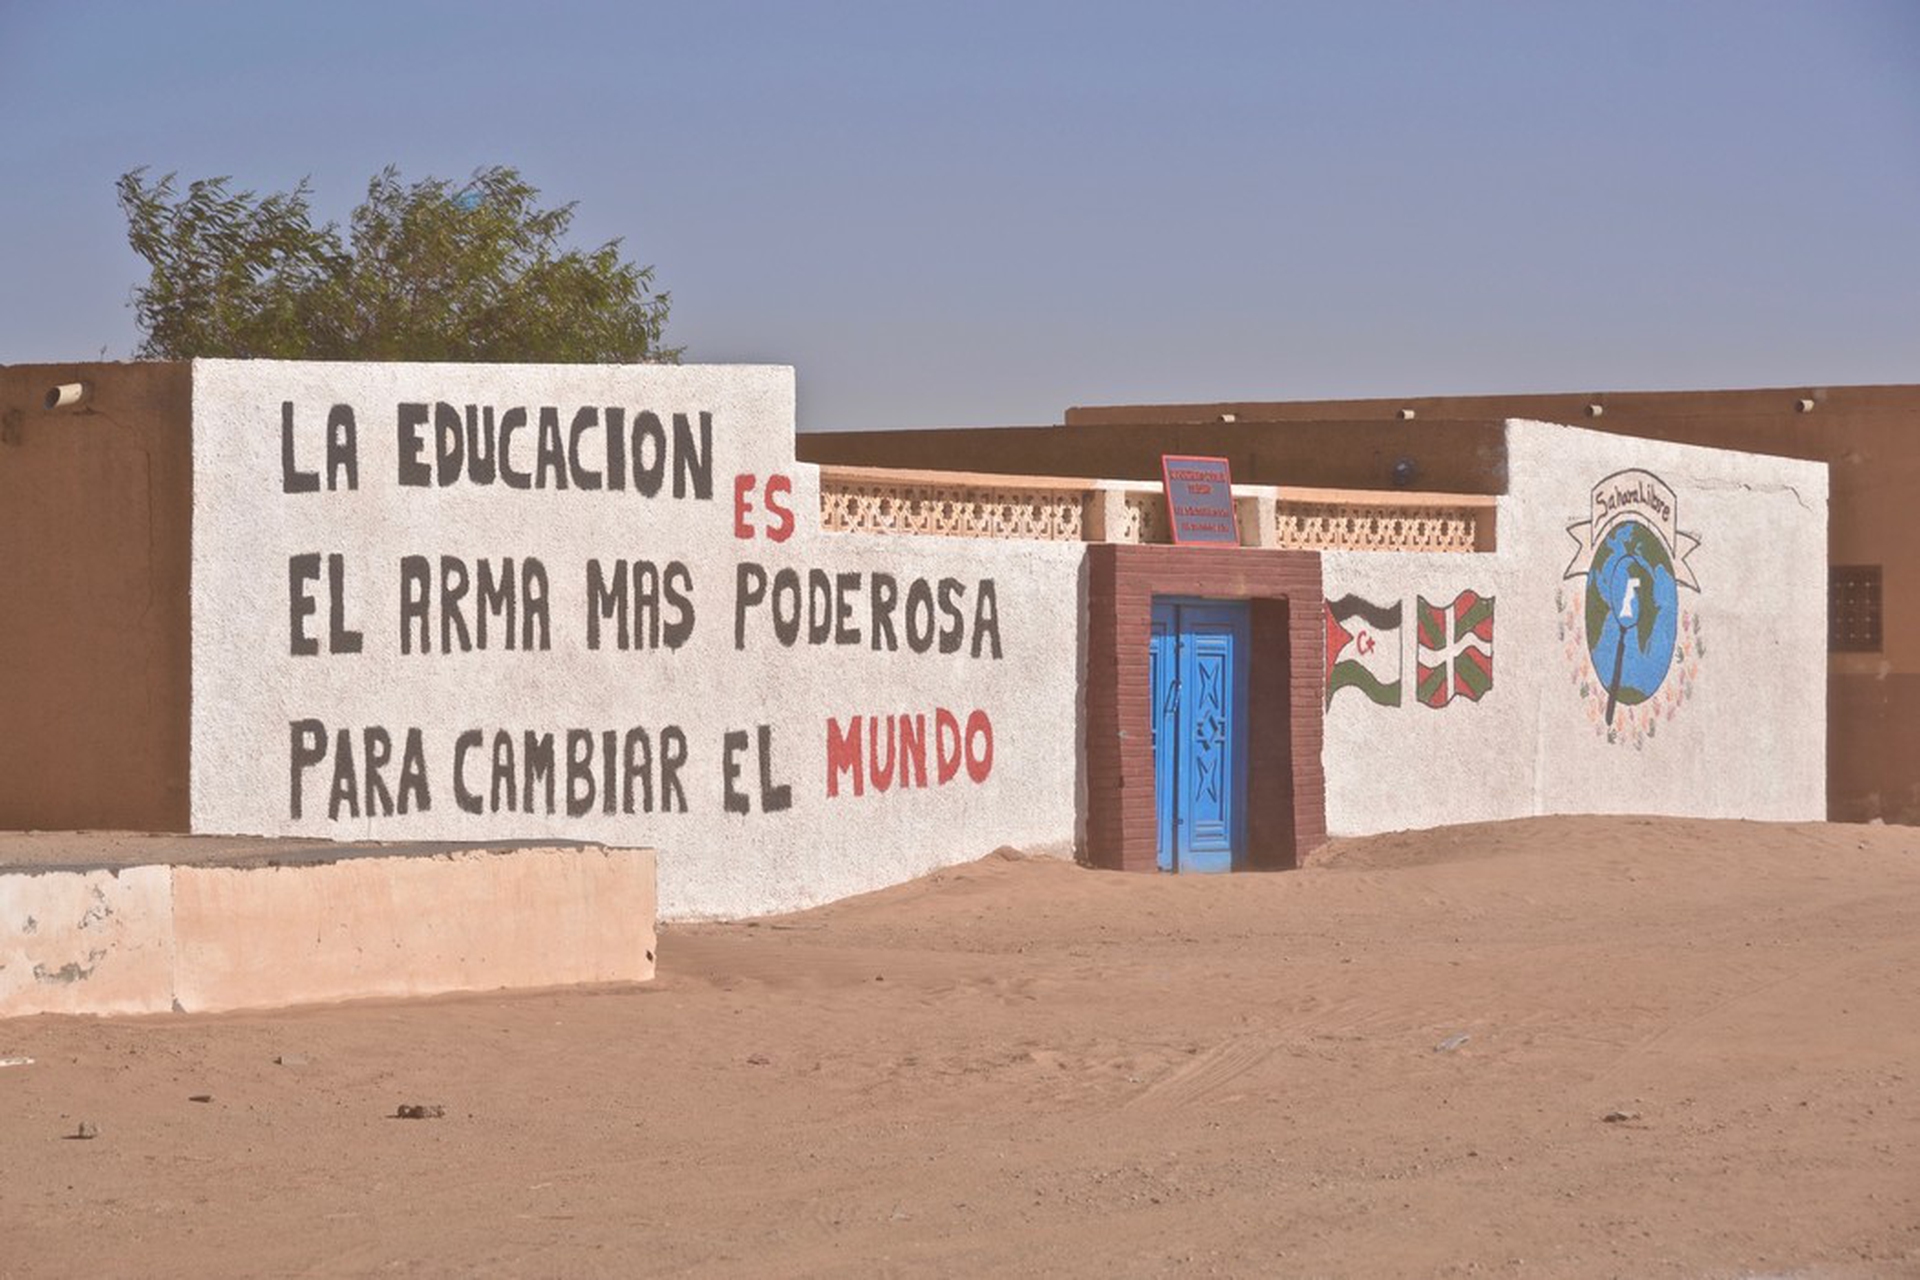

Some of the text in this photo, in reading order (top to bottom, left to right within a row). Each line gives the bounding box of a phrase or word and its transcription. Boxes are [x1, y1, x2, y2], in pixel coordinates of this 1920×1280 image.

[281, 401, 795, 543] LA EDUCACION ES
[288, 552, 1003, 660] EL ARMA MAS PODEROSA
[288, 707, 994, 822] PARA CAMBIAR EL MUNDO
